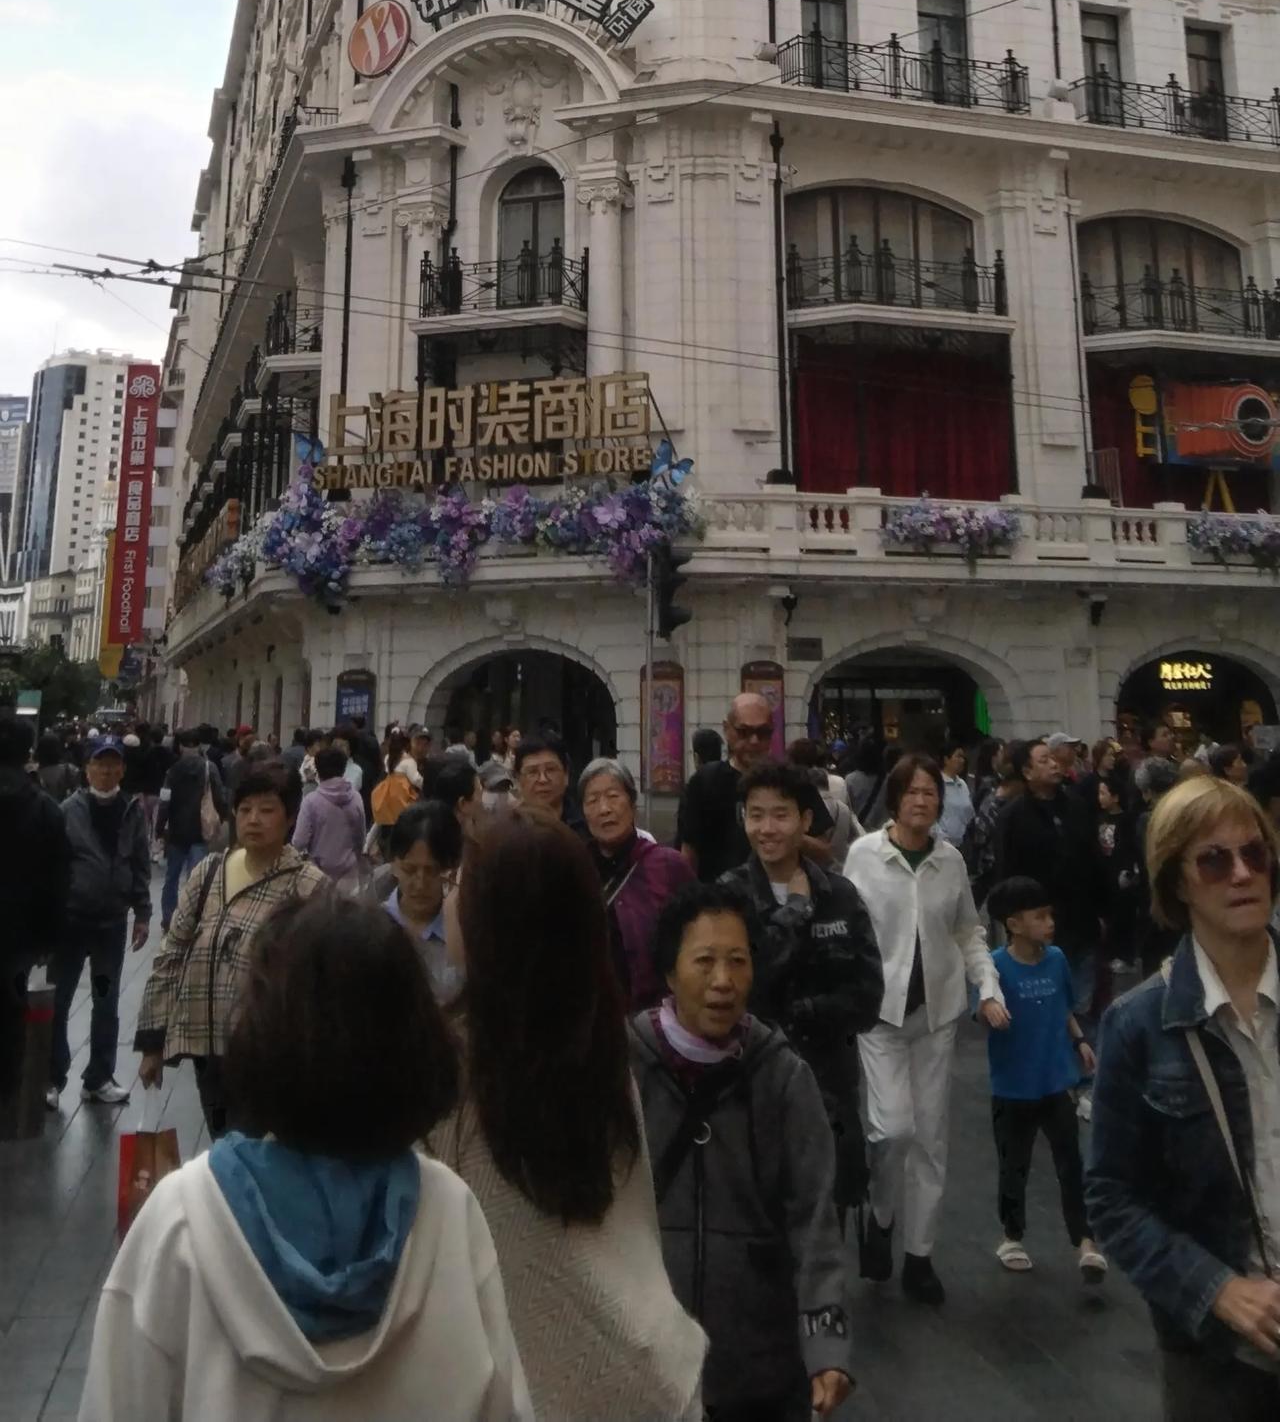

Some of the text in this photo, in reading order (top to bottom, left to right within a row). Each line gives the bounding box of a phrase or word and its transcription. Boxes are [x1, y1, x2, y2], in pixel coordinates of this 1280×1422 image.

[327, 372, 650, 456] 上海时装商店
[313, 447, 650, 490] SHANGHAI FASHION STORE
